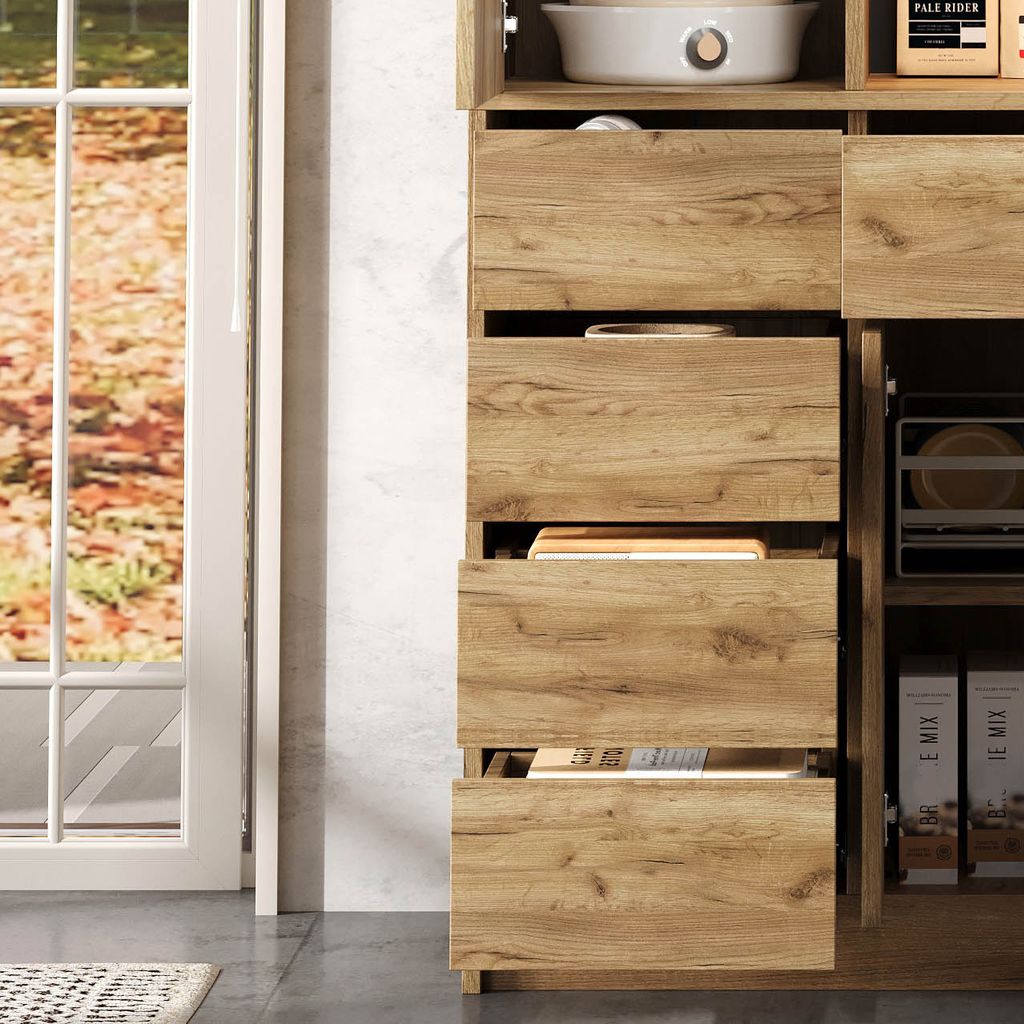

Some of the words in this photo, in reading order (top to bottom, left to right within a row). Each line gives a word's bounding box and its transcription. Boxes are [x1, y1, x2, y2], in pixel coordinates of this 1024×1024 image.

[914, 3, 941, 13] PALE
[945, 3, 980, 13] RIDER
[920, 716, 939, 744] MIX
[987, 710, 1007, 737] MIX
